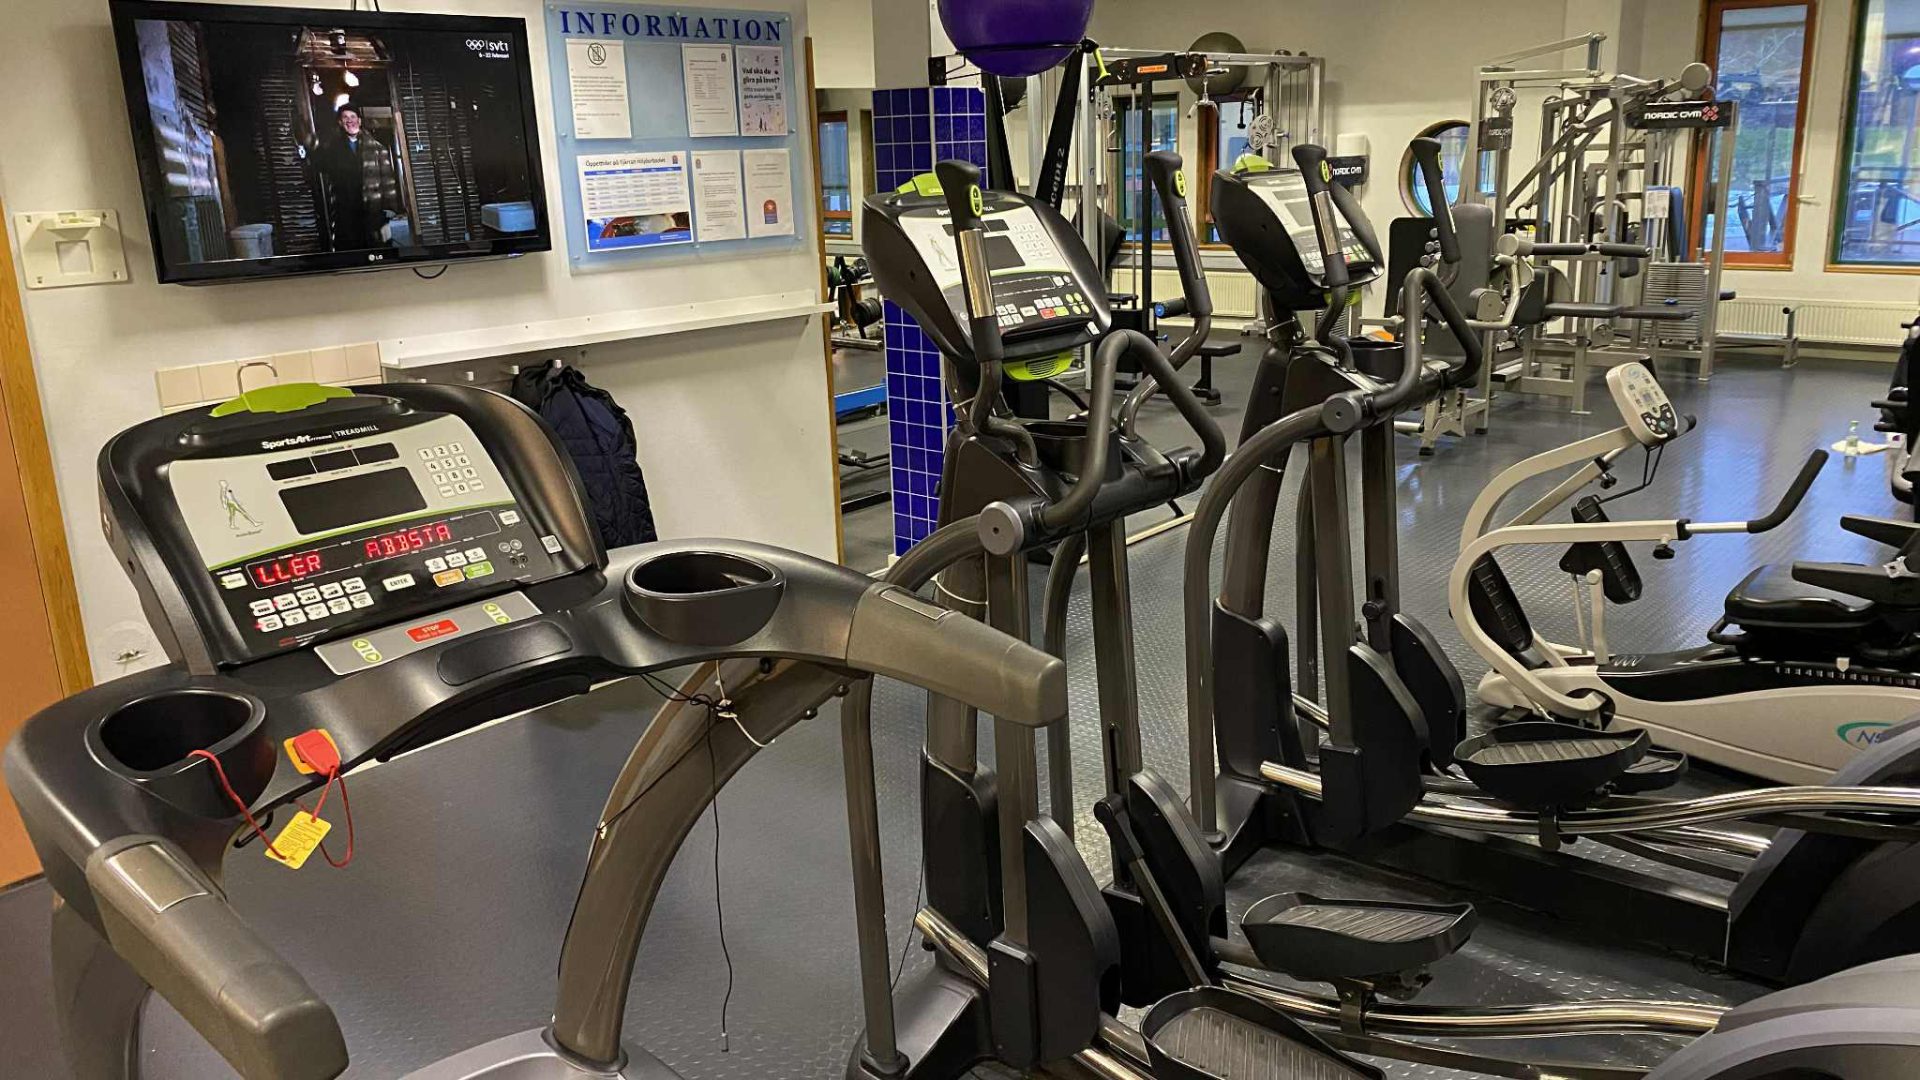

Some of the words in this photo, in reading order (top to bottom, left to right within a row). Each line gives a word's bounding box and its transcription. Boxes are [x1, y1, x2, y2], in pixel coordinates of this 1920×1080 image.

[560, 11, 781, 41] INFORMATION
[261, 434, 312, 449] SportsArt
[336, 425, 379, 437] TREADMILL
[257, 555, 321, 583] LLER
[390, 578, 409, 587] ENTER
